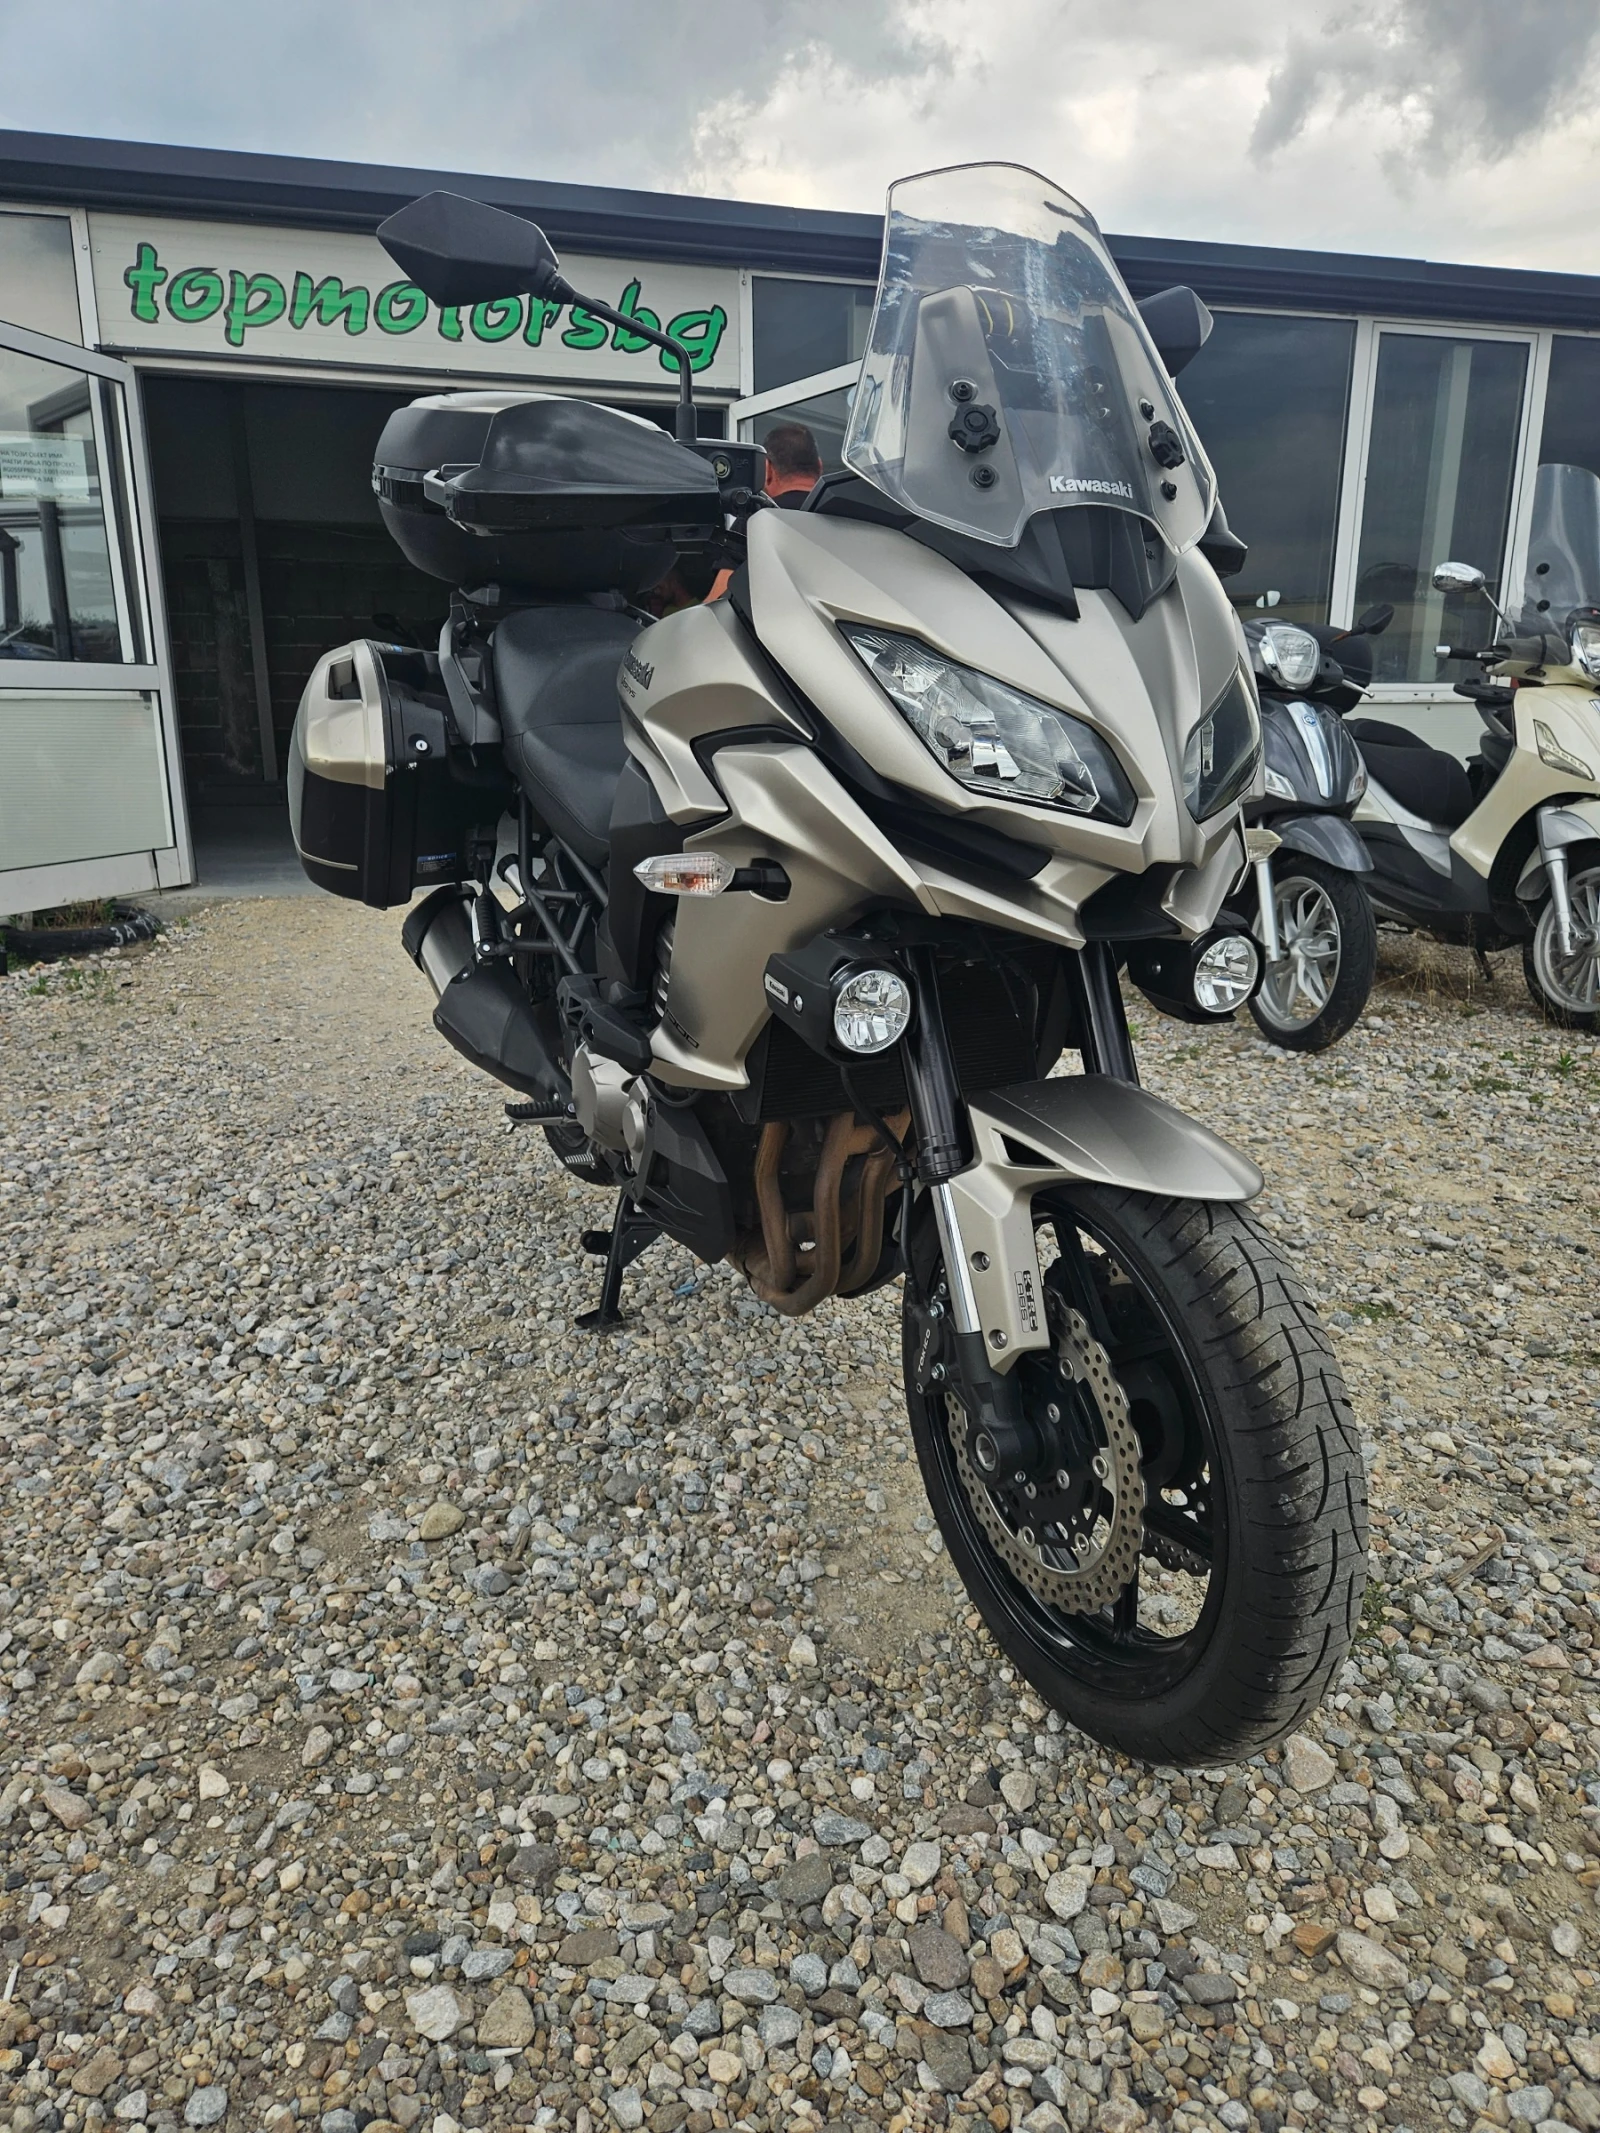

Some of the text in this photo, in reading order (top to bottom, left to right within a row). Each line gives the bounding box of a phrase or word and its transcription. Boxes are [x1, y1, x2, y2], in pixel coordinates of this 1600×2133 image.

[1049, 475, 1133, 499] Kawasaki
[1017, 1282, 1029, 1321] ABS
[917, 1328, 931, 1373] TOKICO
